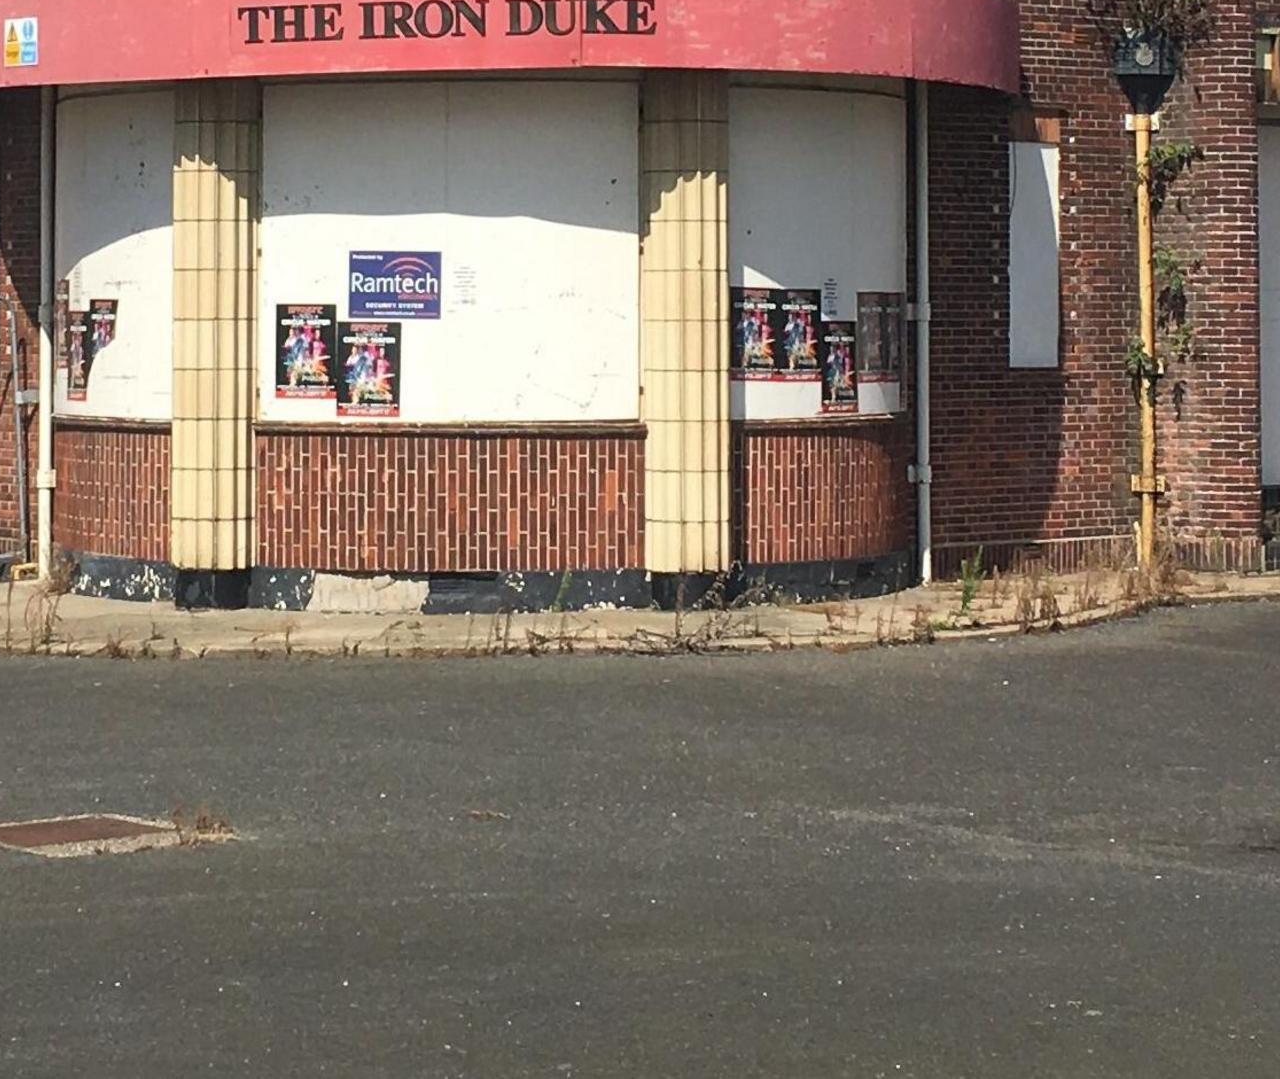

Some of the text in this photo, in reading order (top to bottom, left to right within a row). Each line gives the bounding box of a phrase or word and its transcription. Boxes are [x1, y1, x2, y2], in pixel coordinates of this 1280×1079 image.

[238, 3, 344, 44] THE
[358, 0, 489, 40] IRON
[351, 272, 439, 294] Ramtech
